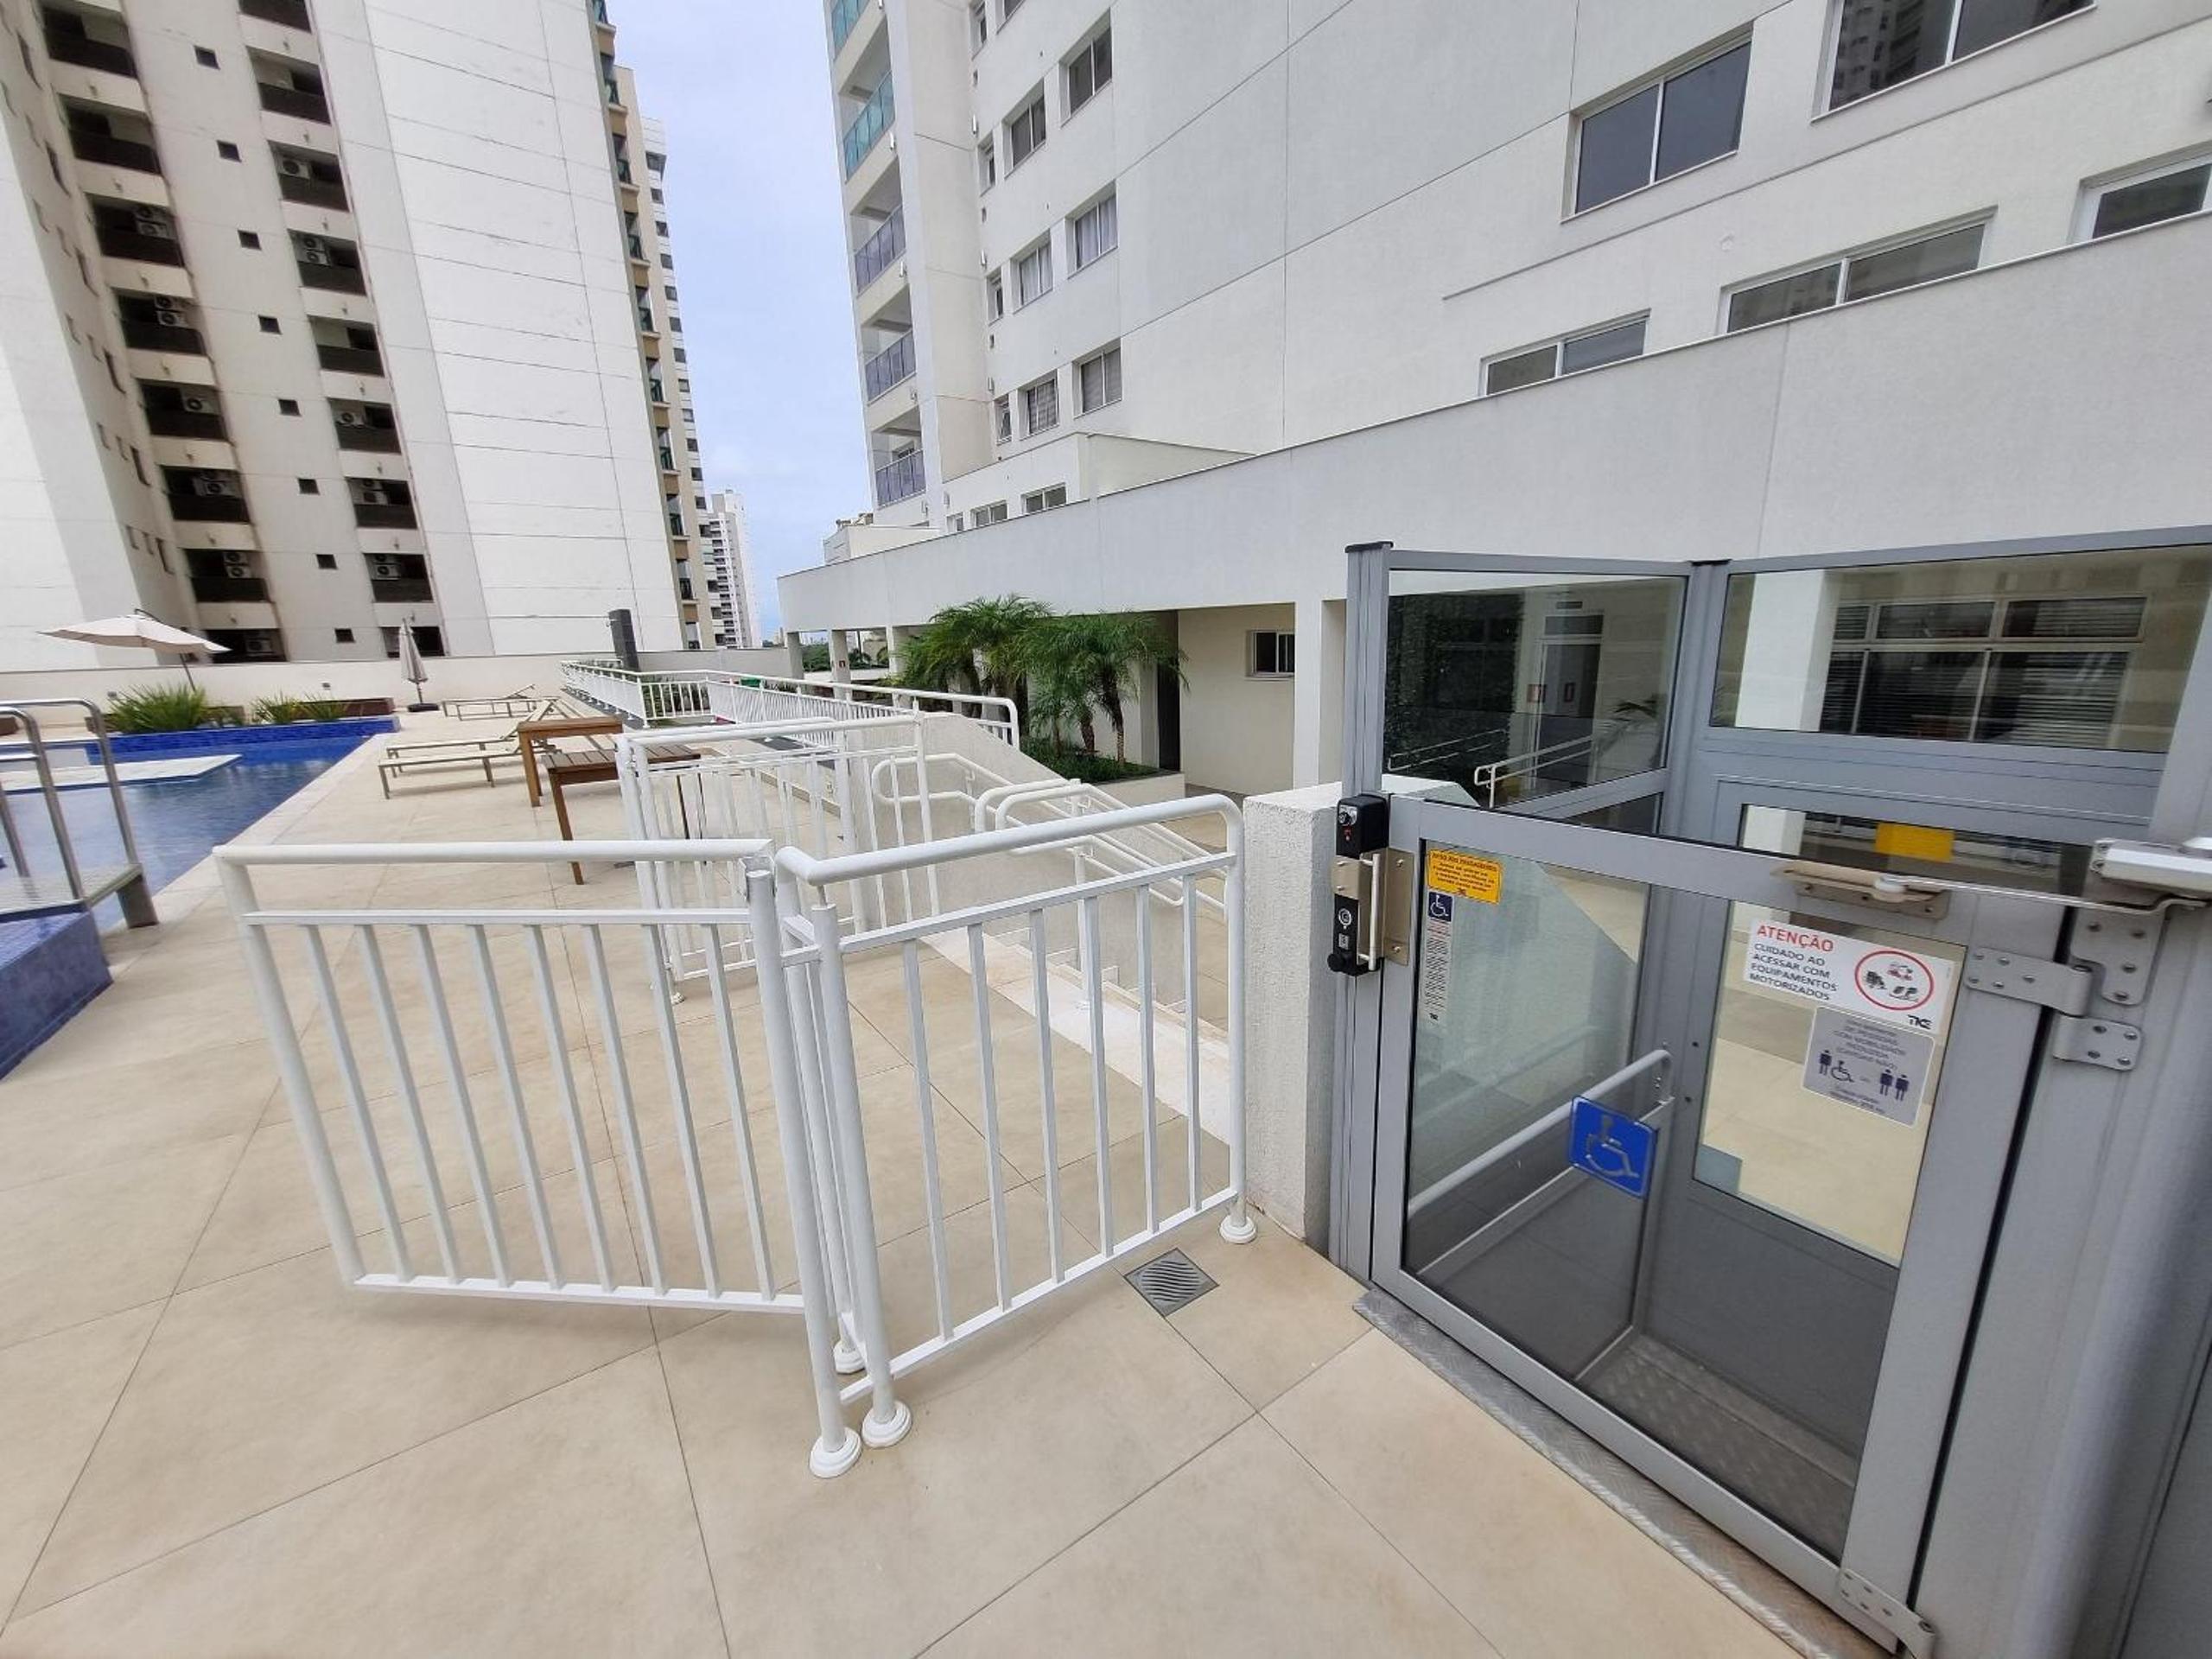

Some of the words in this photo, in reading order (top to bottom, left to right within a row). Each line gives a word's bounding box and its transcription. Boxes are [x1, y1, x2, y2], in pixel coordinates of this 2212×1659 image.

[1757, 925, 1834, 952] ATENÇÃO
[1752, 953, 1801, 970] ACESSAR
[1802, 965, 1831, 979] COM
[1754, 943, 1804, 962] CUIDADO
[1808, 956, 1826, 966] AO
[1749, 973, 1831, 1001] MOTORIZADOS
[1751, 963, 1839, 992] EQUIPAMENTOS
